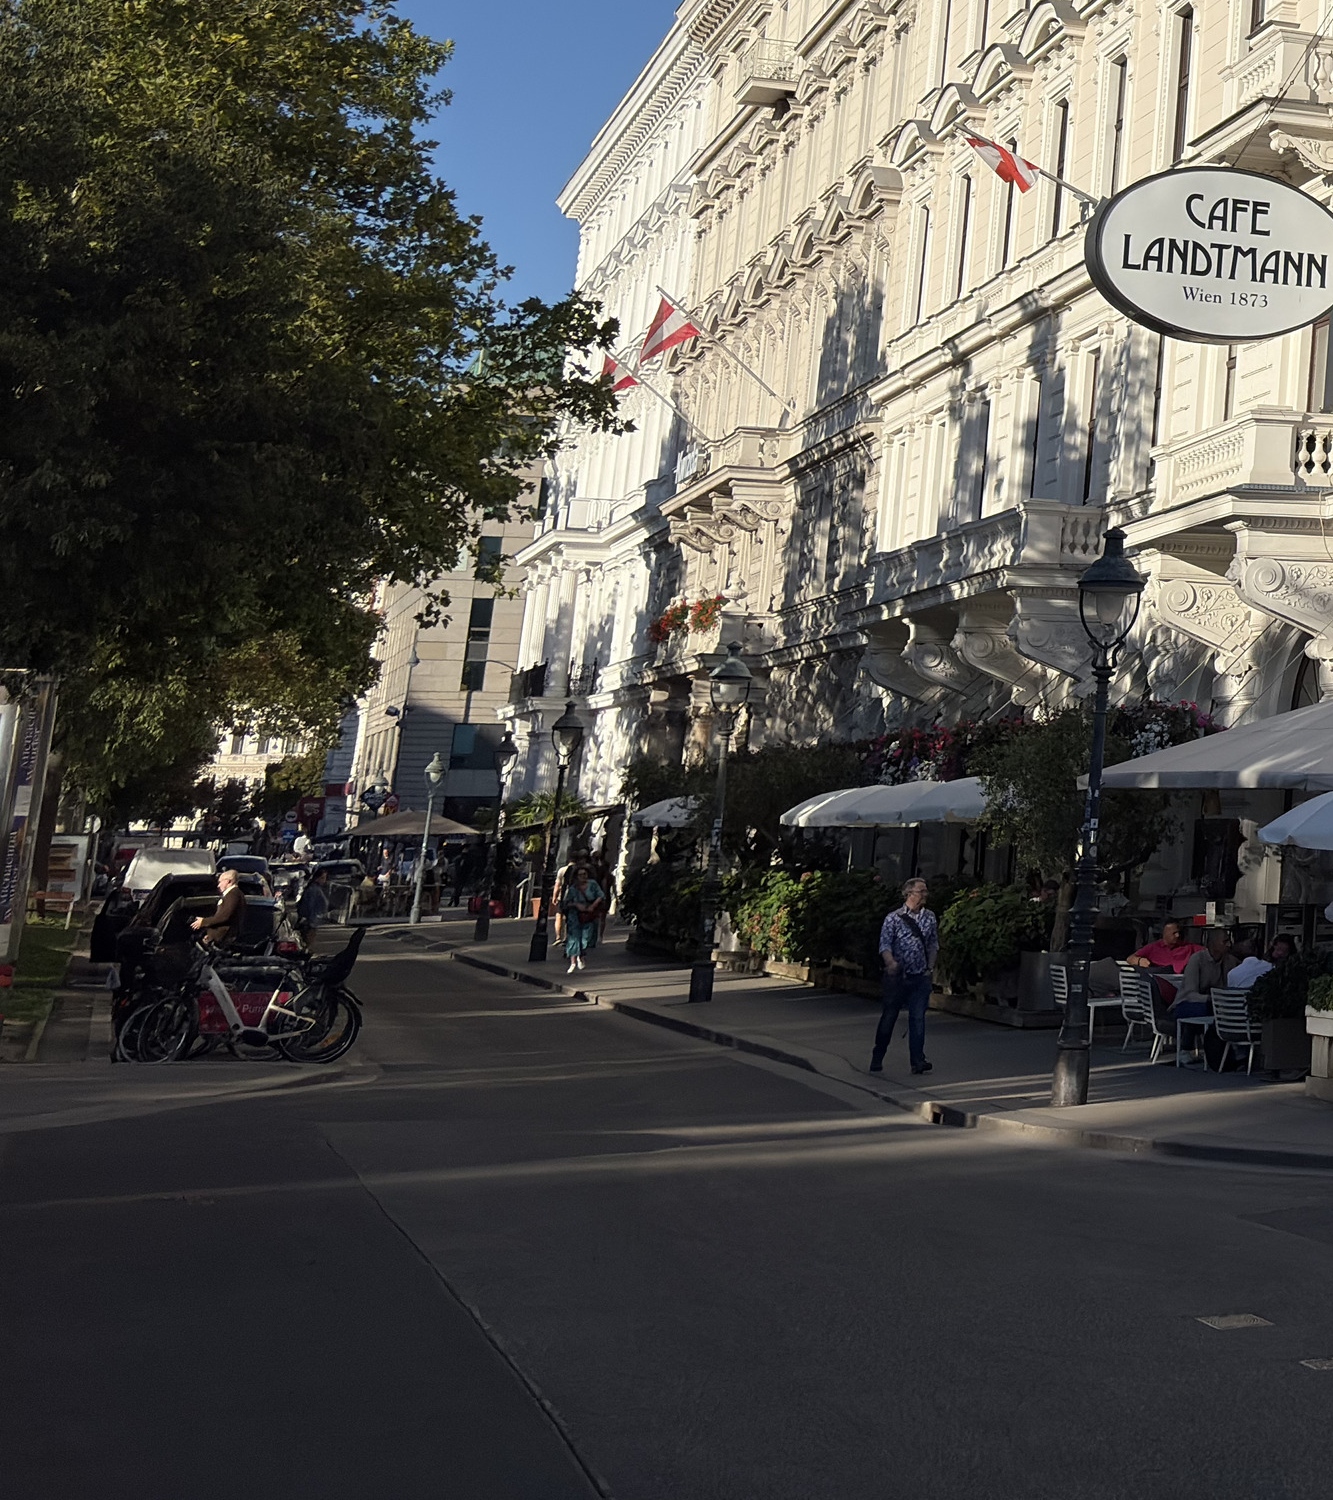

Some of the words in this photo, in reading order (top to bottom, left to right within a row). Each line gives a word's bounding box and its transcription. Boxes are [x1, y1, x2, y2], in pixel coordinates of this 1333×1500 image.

[1185, 193, 1270, 236] CAFE
[1122, 233, 1328, 289] LANDTMANN
[1183, 286, 1223, 305] Wien
[1229, 291, 1269, 309] 1873
